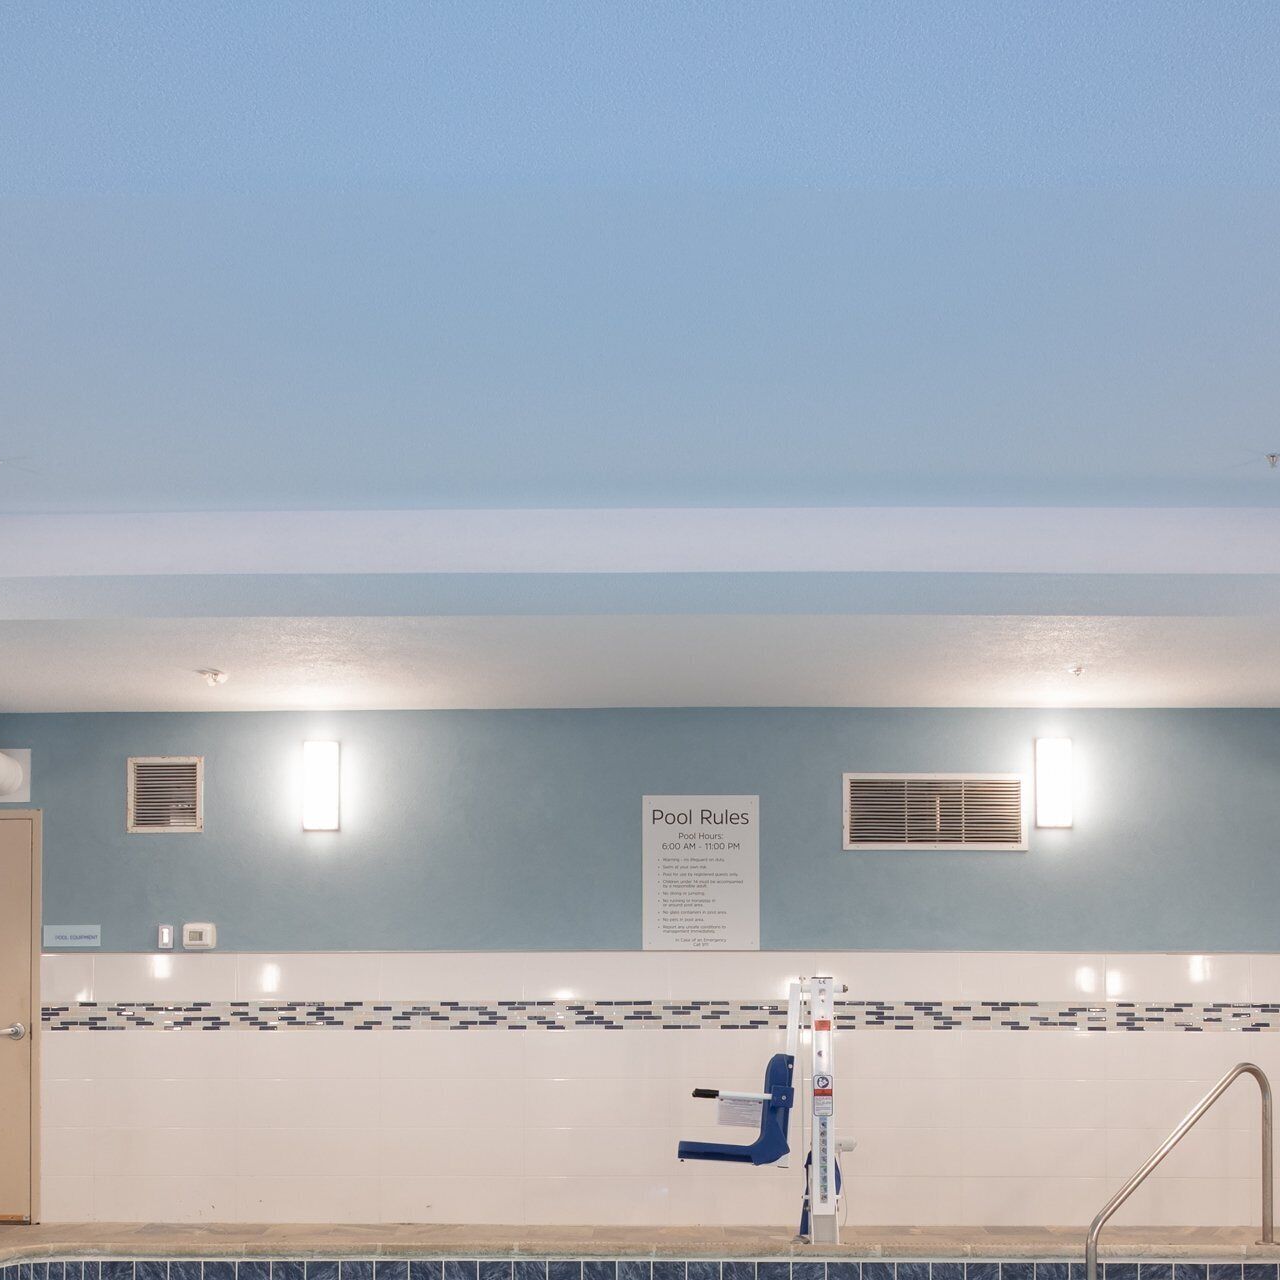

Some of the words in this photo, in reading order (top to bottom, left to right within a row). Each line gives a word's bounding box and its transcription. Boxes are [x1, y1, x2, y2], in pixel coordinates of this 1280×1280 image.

[652, 809, 692, 825] Pool
[700, 809, 749, 825] Rules
[678, 832, 696, 840] Pool
[698, 832, 724, 840] Hours:
[662, 842, 681, 850] 6:00
[683, 842, 696, 850] AM
[705, 842, 724, 850] 11:00
[727, 842, 740, 850] PM
